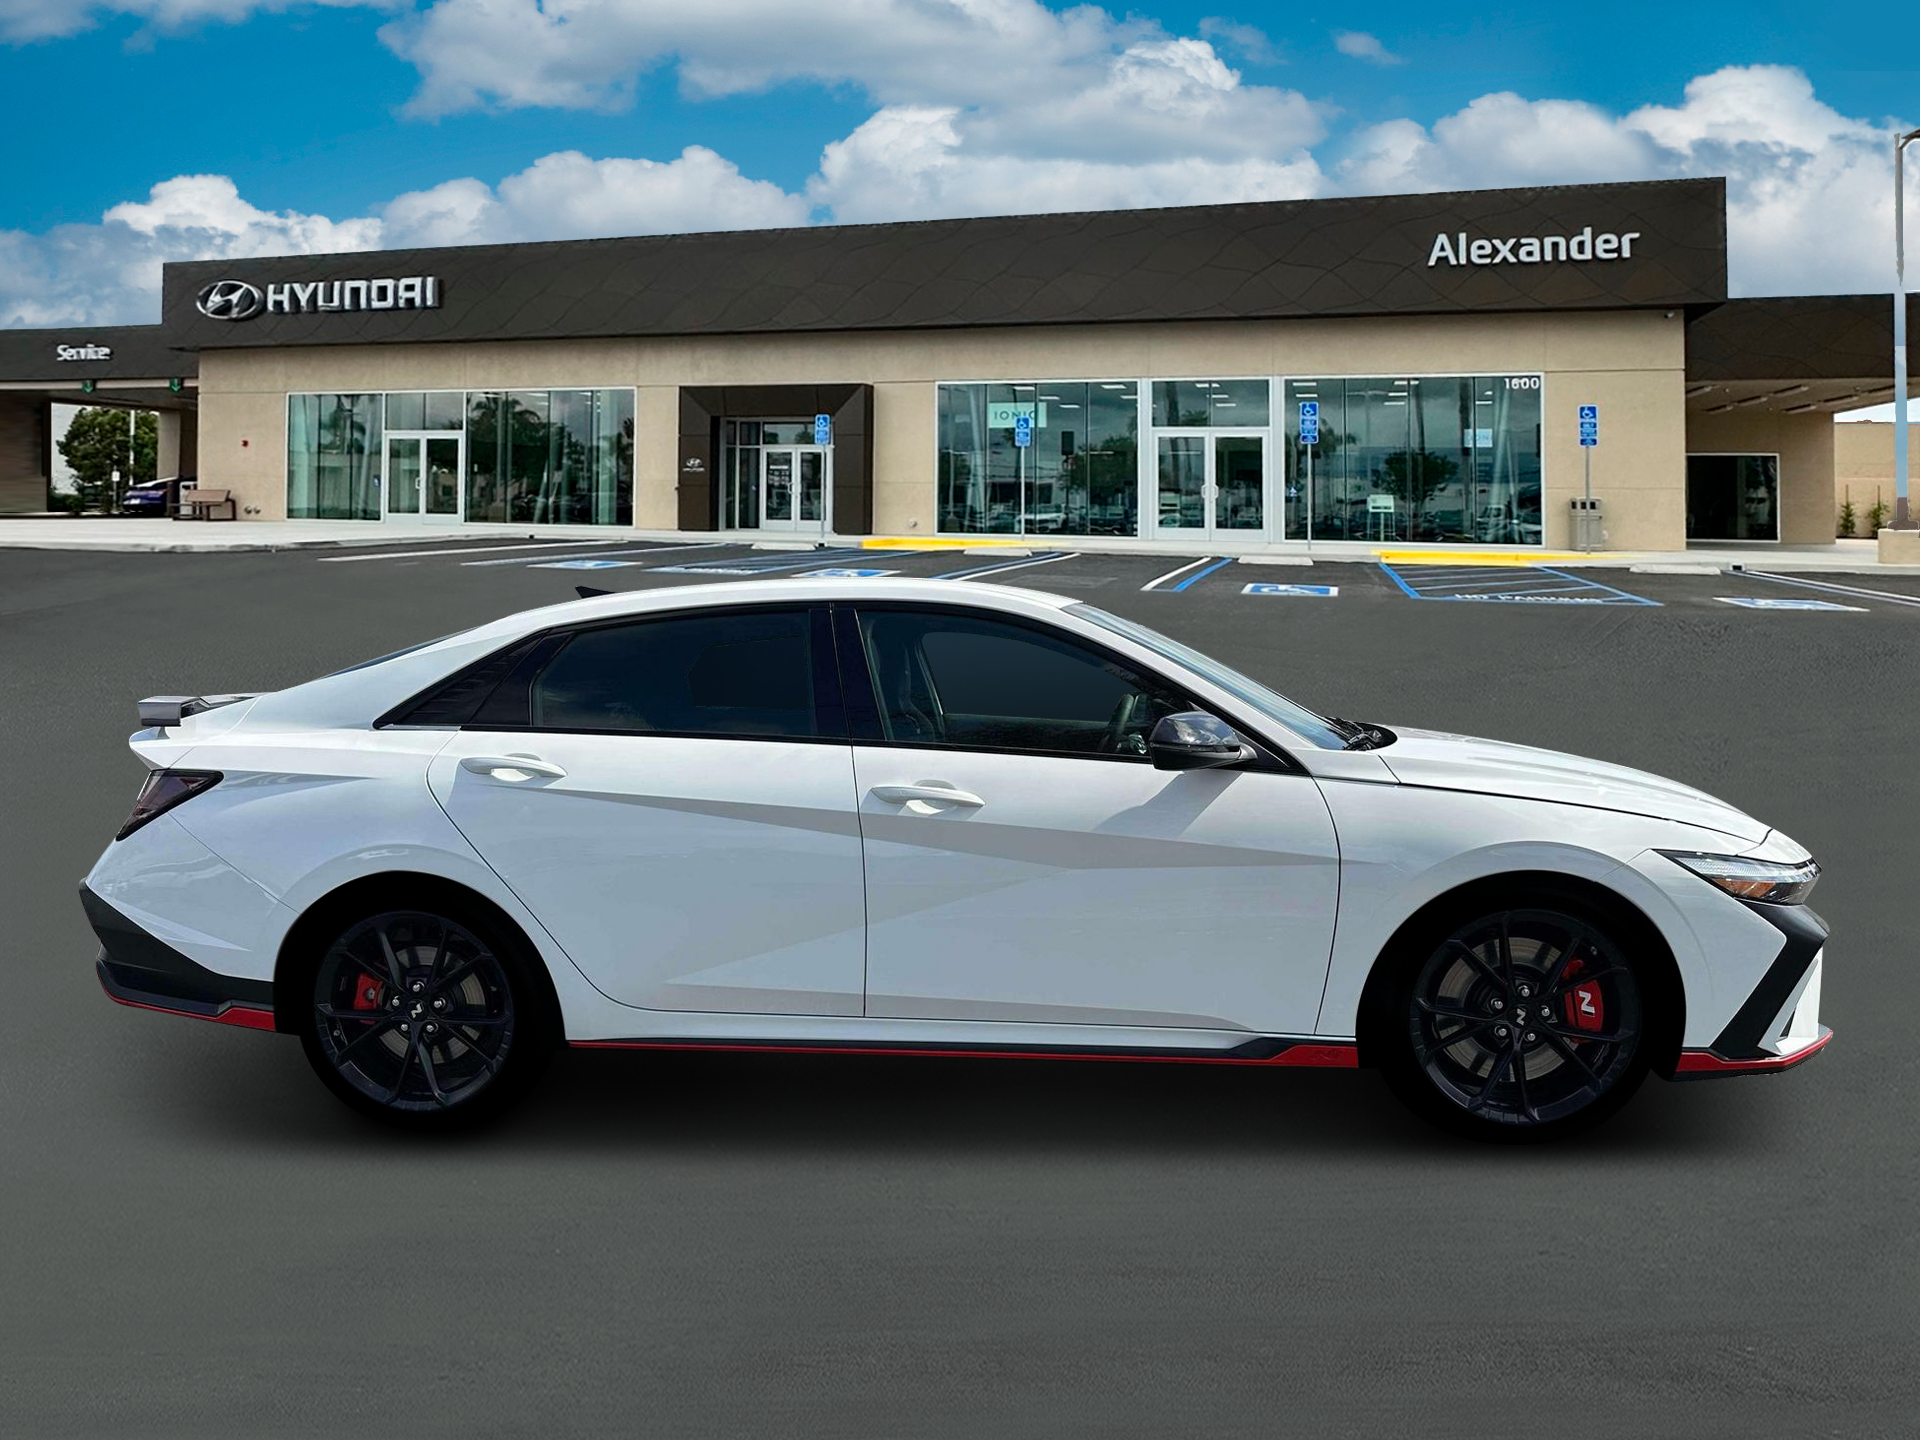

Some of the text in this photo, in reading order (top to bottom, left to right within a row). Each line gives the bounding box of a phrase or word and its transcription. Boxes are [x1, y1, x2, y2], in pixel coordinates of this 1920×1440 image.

[1427, 226, 1640, 267] Alexander
[266, 277, 440, 313] HYUNDAI
[56, 343, 111, 361] Service
[1504, 377, 1540, 390] 1600
